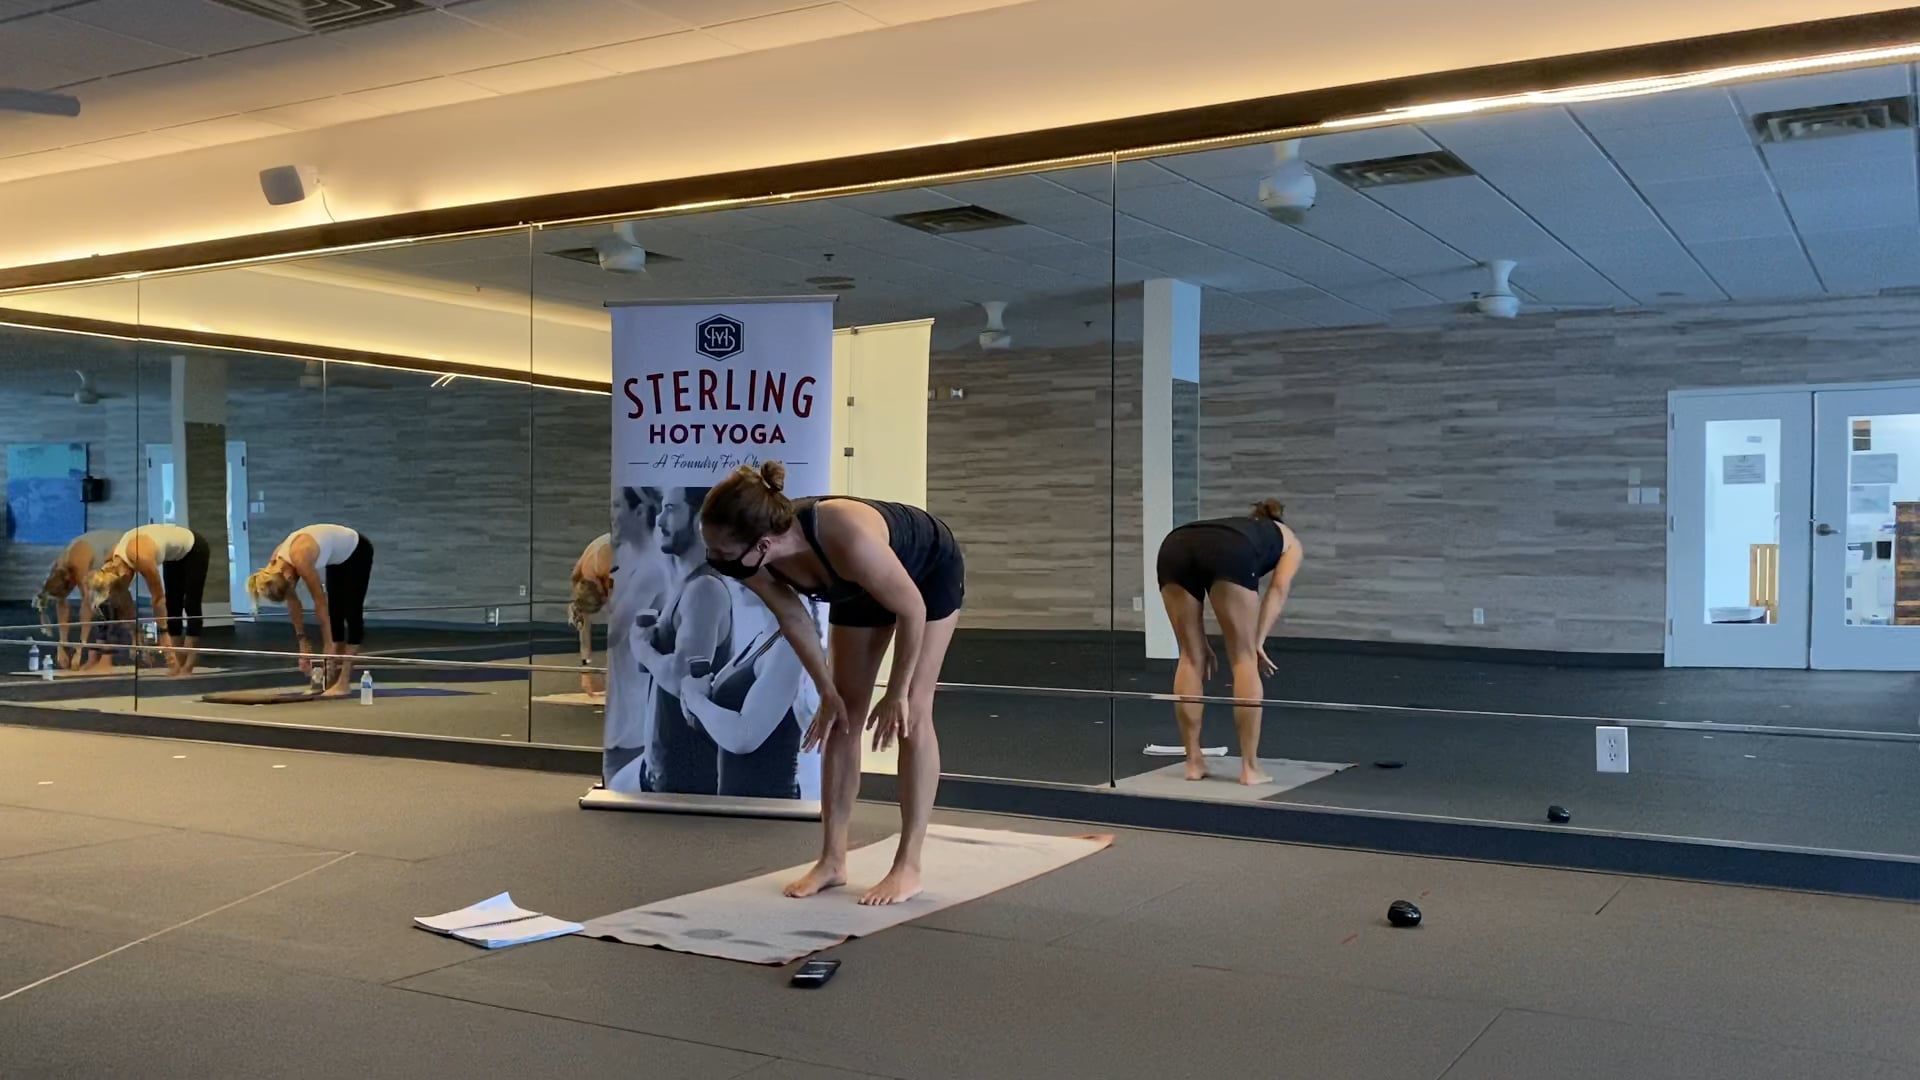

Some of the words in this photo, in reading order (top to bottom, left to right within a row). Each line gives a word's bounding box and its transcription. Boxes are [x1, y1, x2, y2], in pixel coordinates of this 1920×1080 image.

[623, 369, 817, 419] STERLING
[650, 424, 706, 444] HOT
[712, 424, 786, 444] YOGA
[652, 453, 669, 469] A
[671, 453, 719, 473] Foundry
